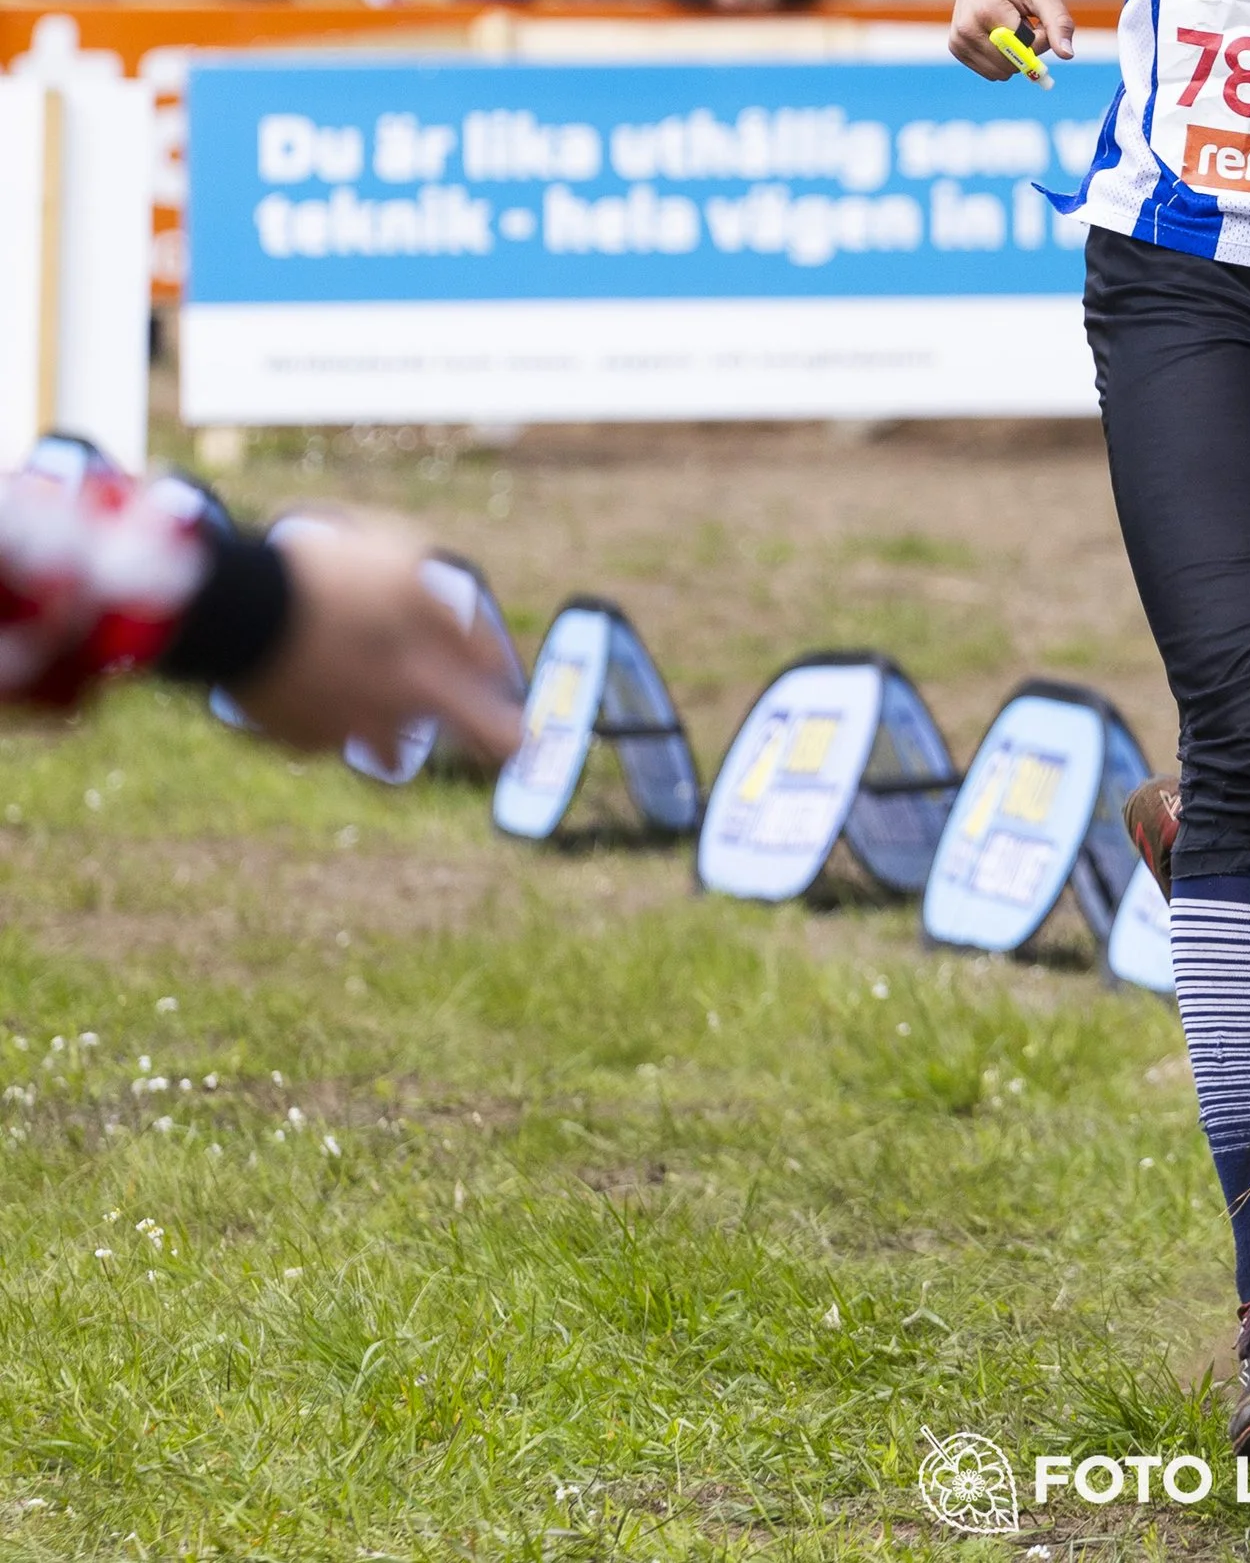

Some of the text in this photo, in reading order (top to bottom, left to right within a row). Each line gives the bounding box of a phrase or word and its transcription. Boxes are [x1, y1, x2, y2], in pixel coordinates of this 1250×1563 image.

[257, 111, 365, 185] Du
[373, 110, 457, 185] är
[462, 107, 602, 183] lika
[610, 105, 892, 193] uthållig
[897, 118, 1050, 180] som
[253, 183, 496, 259] teknik
[542, 180, 700, 255] hela
[704, 181, 924, 268] vägen
[930, 176, 1007, 252] in
